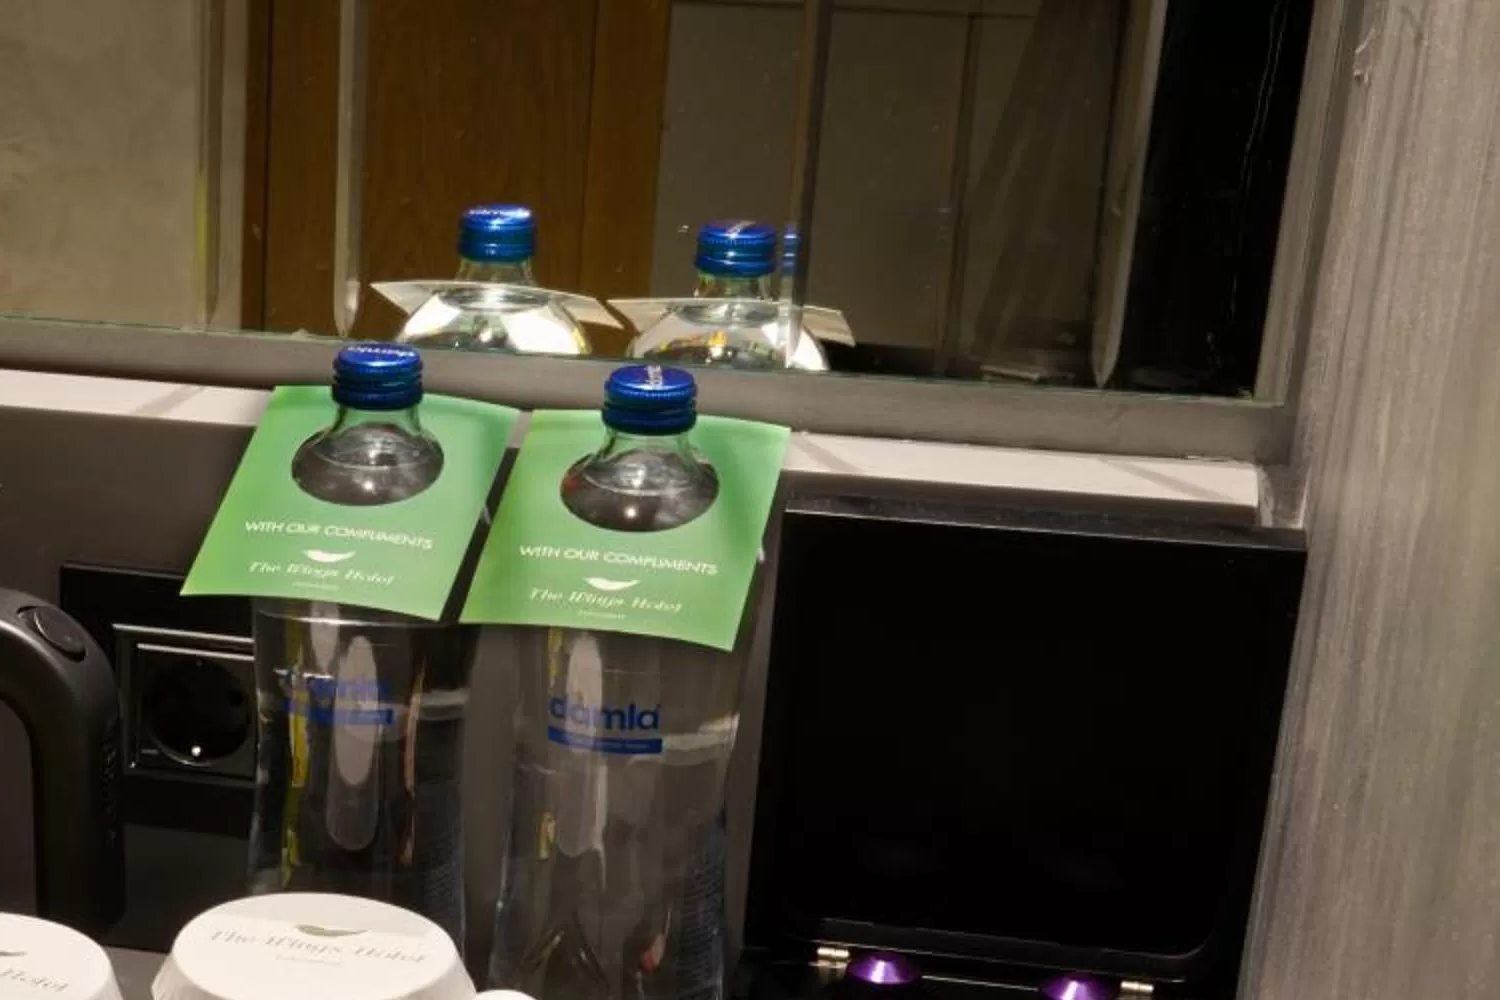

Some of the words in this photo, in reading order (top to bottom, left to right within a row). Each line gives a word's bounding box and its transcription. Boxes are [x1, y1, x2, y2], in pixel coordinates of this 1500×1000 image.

[245, 521, 284, 532] WITH
[286, 522, 321, 535] OUR
[324, 526, 433, 549] COMPLIMENTS
[520, 545, 560, 558] WITH
[564, 548, 599, 561] OUR
[603, 551, 719, 576] COMPLIMENTS
[550, 697, 660, 731] damla
